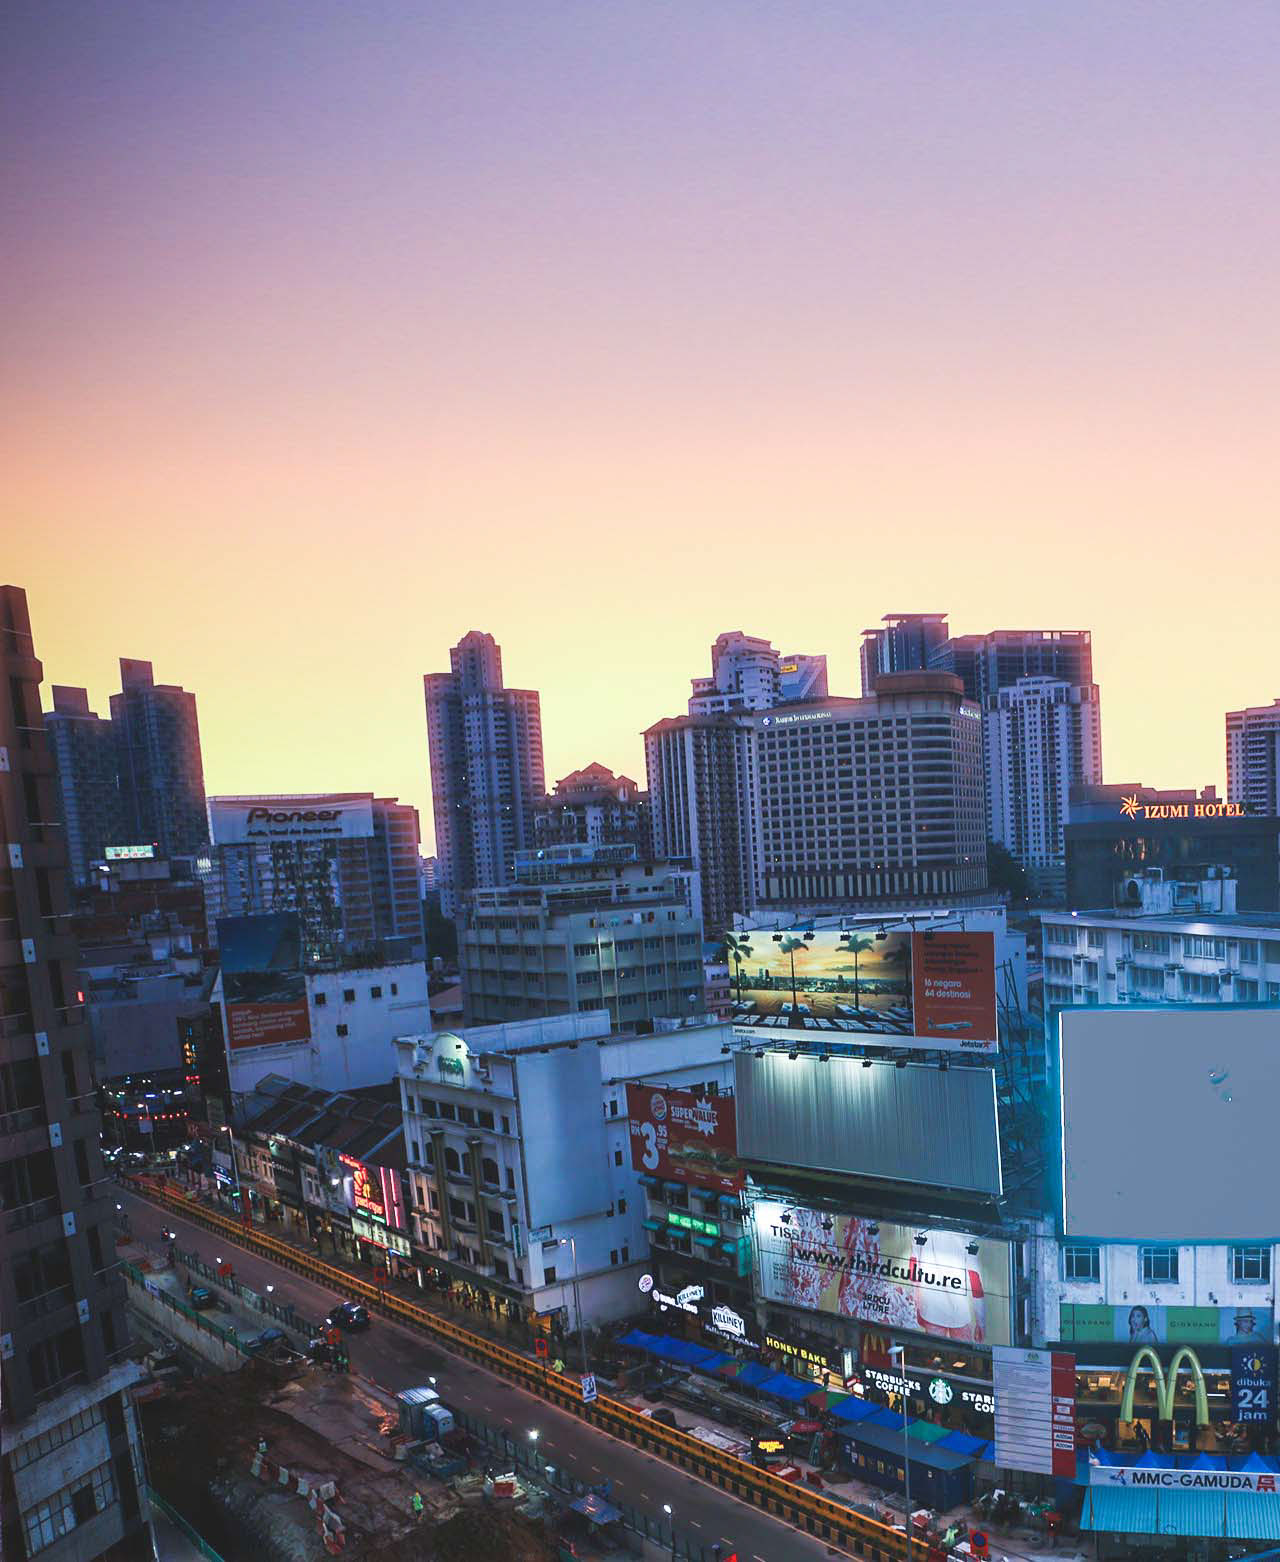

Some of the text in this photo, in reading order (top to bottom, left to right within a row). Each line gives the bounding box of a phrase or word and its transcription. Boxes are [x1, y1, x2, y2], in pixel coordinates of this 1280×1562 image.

[247, 807, 343, 824] Pioneer
[1144, 803, 1246, 819] IZUMI HOTEL
[934, 980, 962, 990] negara
[671, 1106, 693, 1119] SUPER
[640, 1121, 659, 1170] 3
[796, 1248, 962, 1289] www.thirdcultu.re
[678, 1288, 704, 1302] KILLINEY
[713, 1310, 743, 1331] KILLINEY
[1170, 1320, 1217, 1328] GIORDANO
[766, 1336, 798, 1356] HONEY
[800, 1348, 828, 1366] BAKE
[865, 1369, 921, 1392] STARBUCKS
[875, 1379, 912, 1397] COFFEE
[1237, 1377, 1271, 1387] dibuka
[1237, 1389, 1270, 1409] 24
[1237, 1410, 1268, 1422] jam
[1132, 1471, 1253, 1489] MMC-GAMUDA
